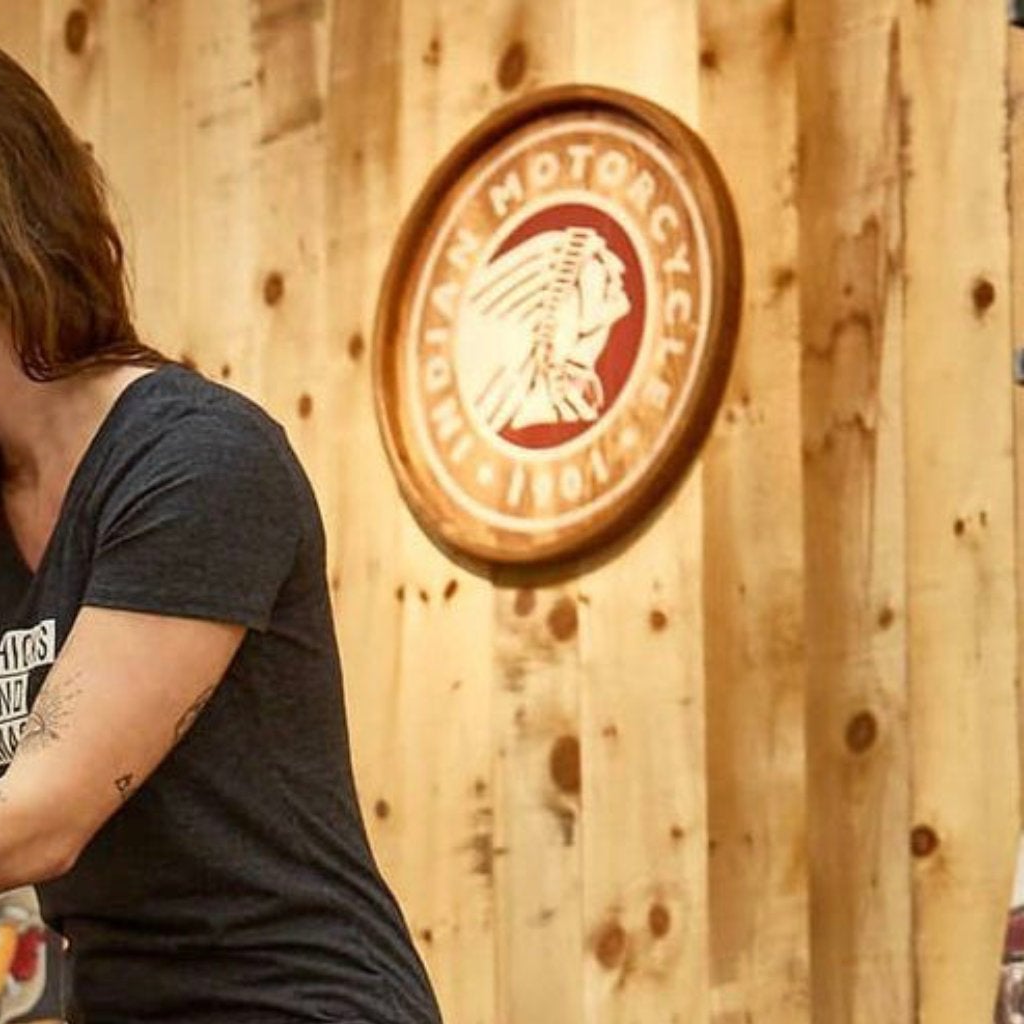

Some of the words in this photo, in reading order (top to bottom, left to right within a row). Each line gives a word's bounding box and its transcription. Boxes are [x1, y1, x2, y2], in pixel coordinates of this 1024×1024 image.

[424, 227, 478, 463] INDIAN
[489, 144, 692, 405] MOTORCYCLE
[506, 446, 609, 507] 1901
